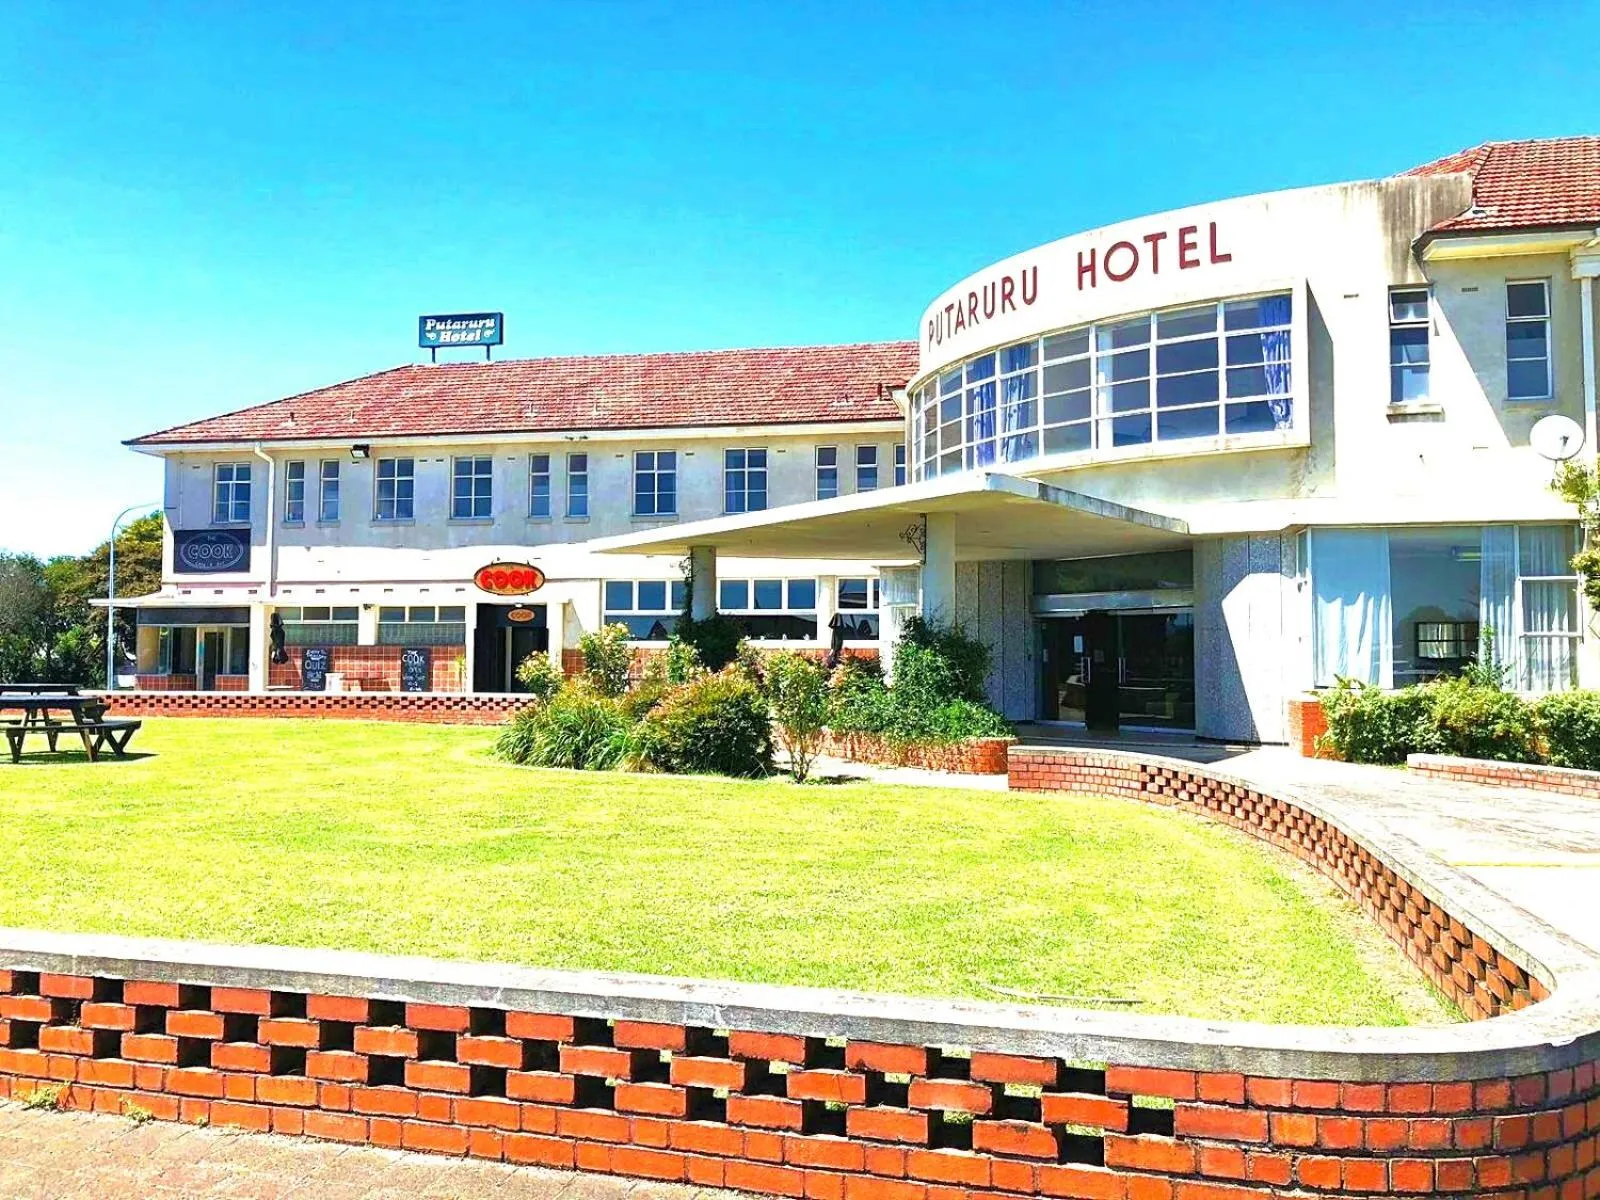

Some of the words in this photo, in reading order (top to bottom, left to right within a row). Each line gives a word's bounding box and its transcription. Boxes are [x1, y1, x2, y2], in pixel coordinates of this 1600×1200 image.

[928, 265, 1038, 352] PUTARURU
[1077, 222, 1232, 290] HOTEL
[425, 318, 495, 330] Putaruru
[439, 329, 481, 342] Hotel
[188, 543, 234, 559] COOK
[480, 570, 538, 590] COOK
[402, 654, 425, 664] COOK
